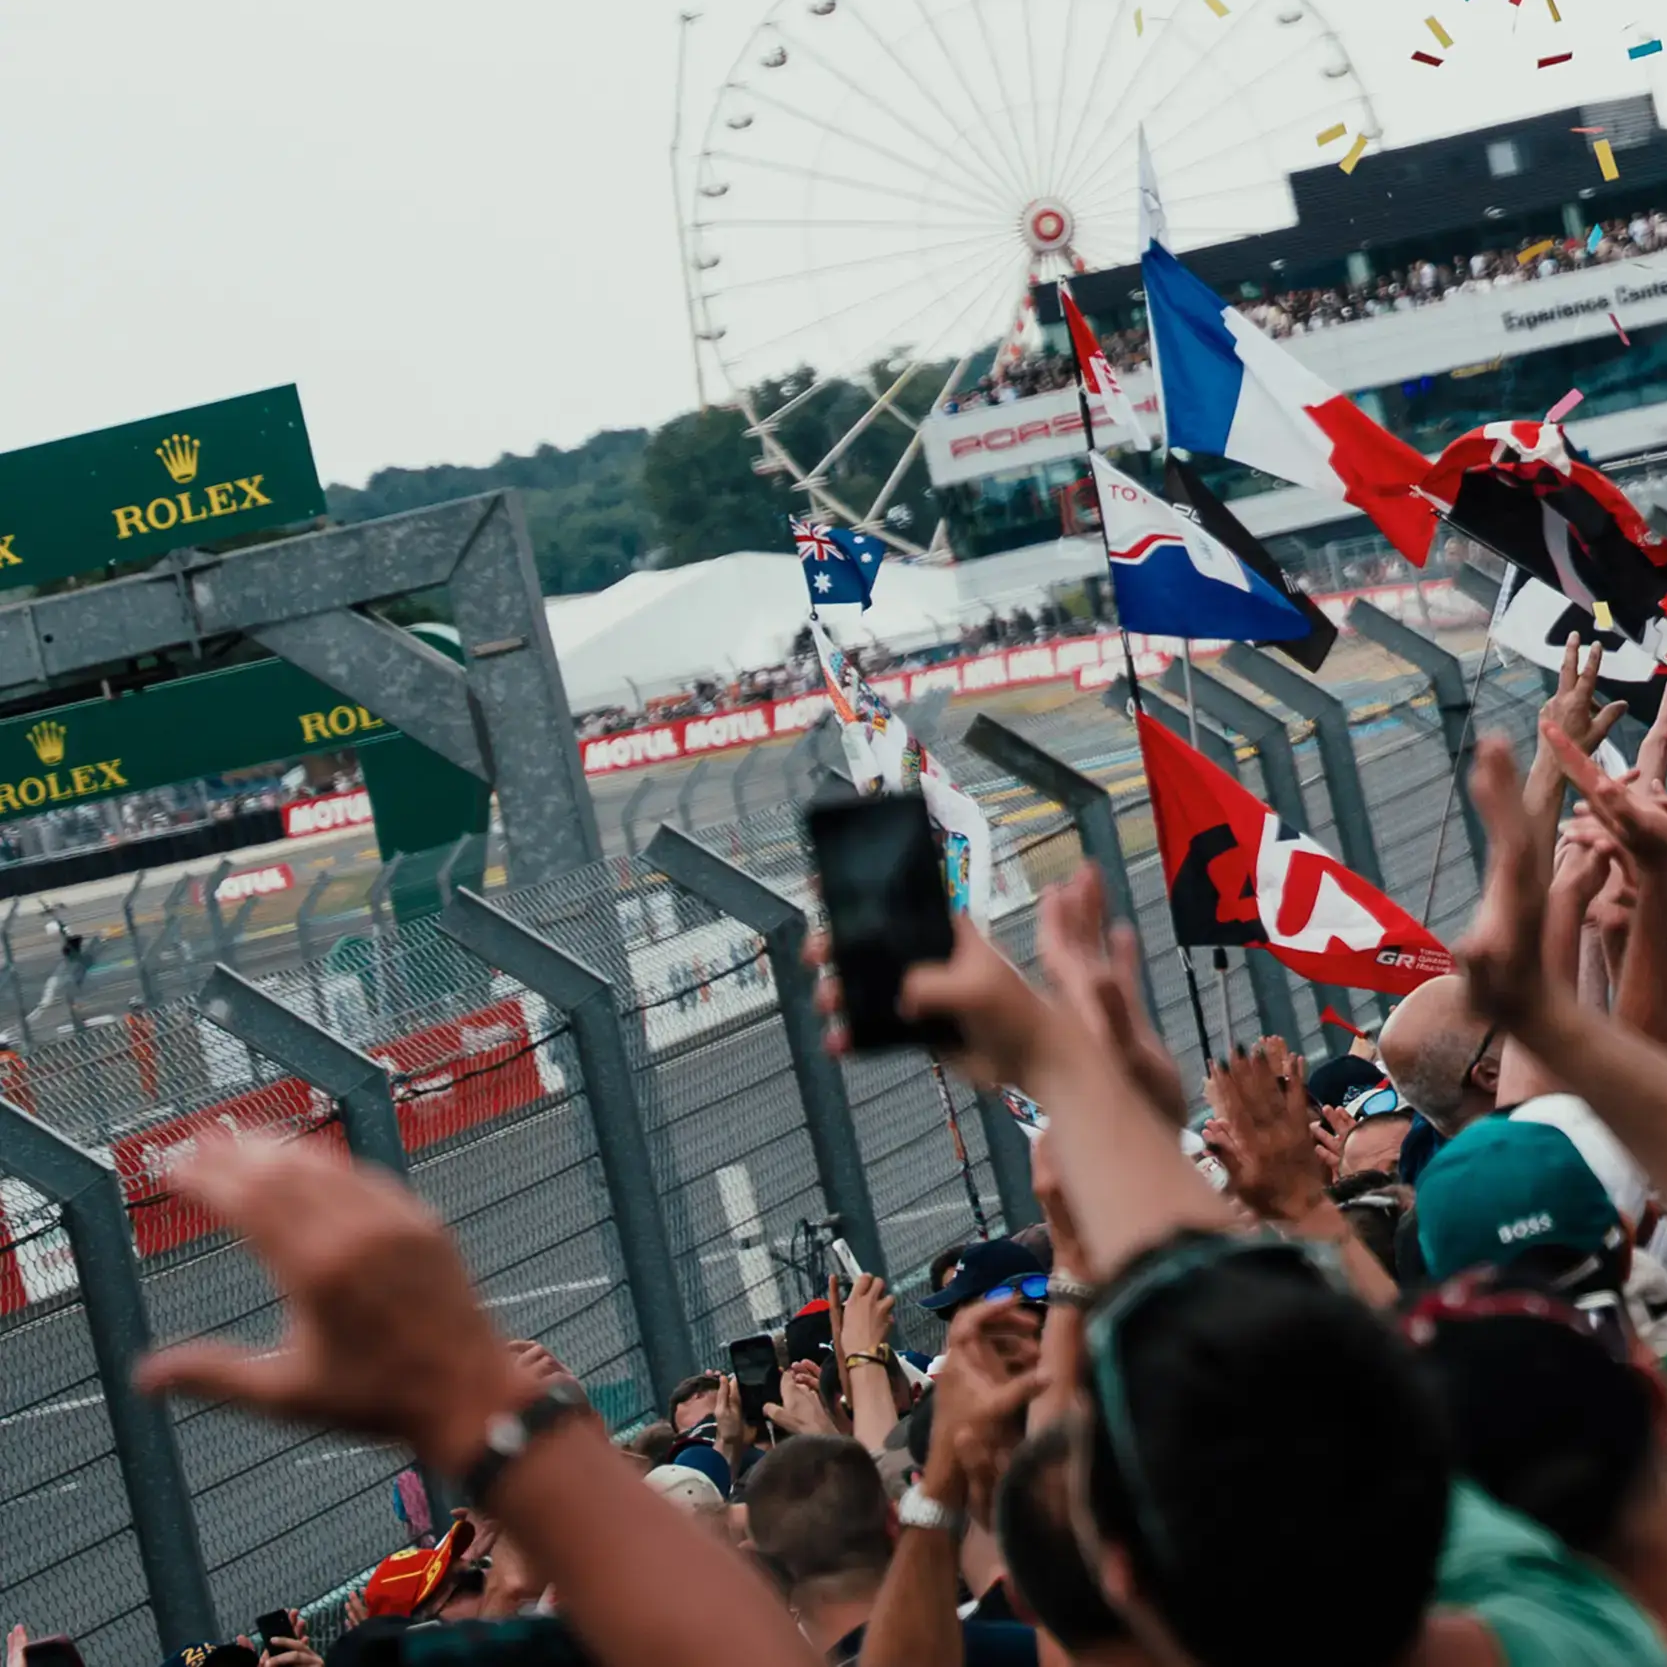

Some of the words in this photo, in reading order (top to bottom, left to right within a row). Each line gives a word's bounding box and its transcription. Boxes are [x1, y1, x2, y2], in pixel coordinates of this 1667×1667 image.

[950, 394, 1159, 459] PORSCH
[111, 474, 274, 540] ROLEX
[298, 705, 385, 744] ROL
[583, 727, 679, 772] MOTUL
[686, 706, 770, 750] MOTUL
[0, 758, 128, 813] ROLEX
[288, 795, 373, 837] MOTU
[214, 865, 287, 903] OTUL
[1497, 1211, 1554, 1245] BOSS
